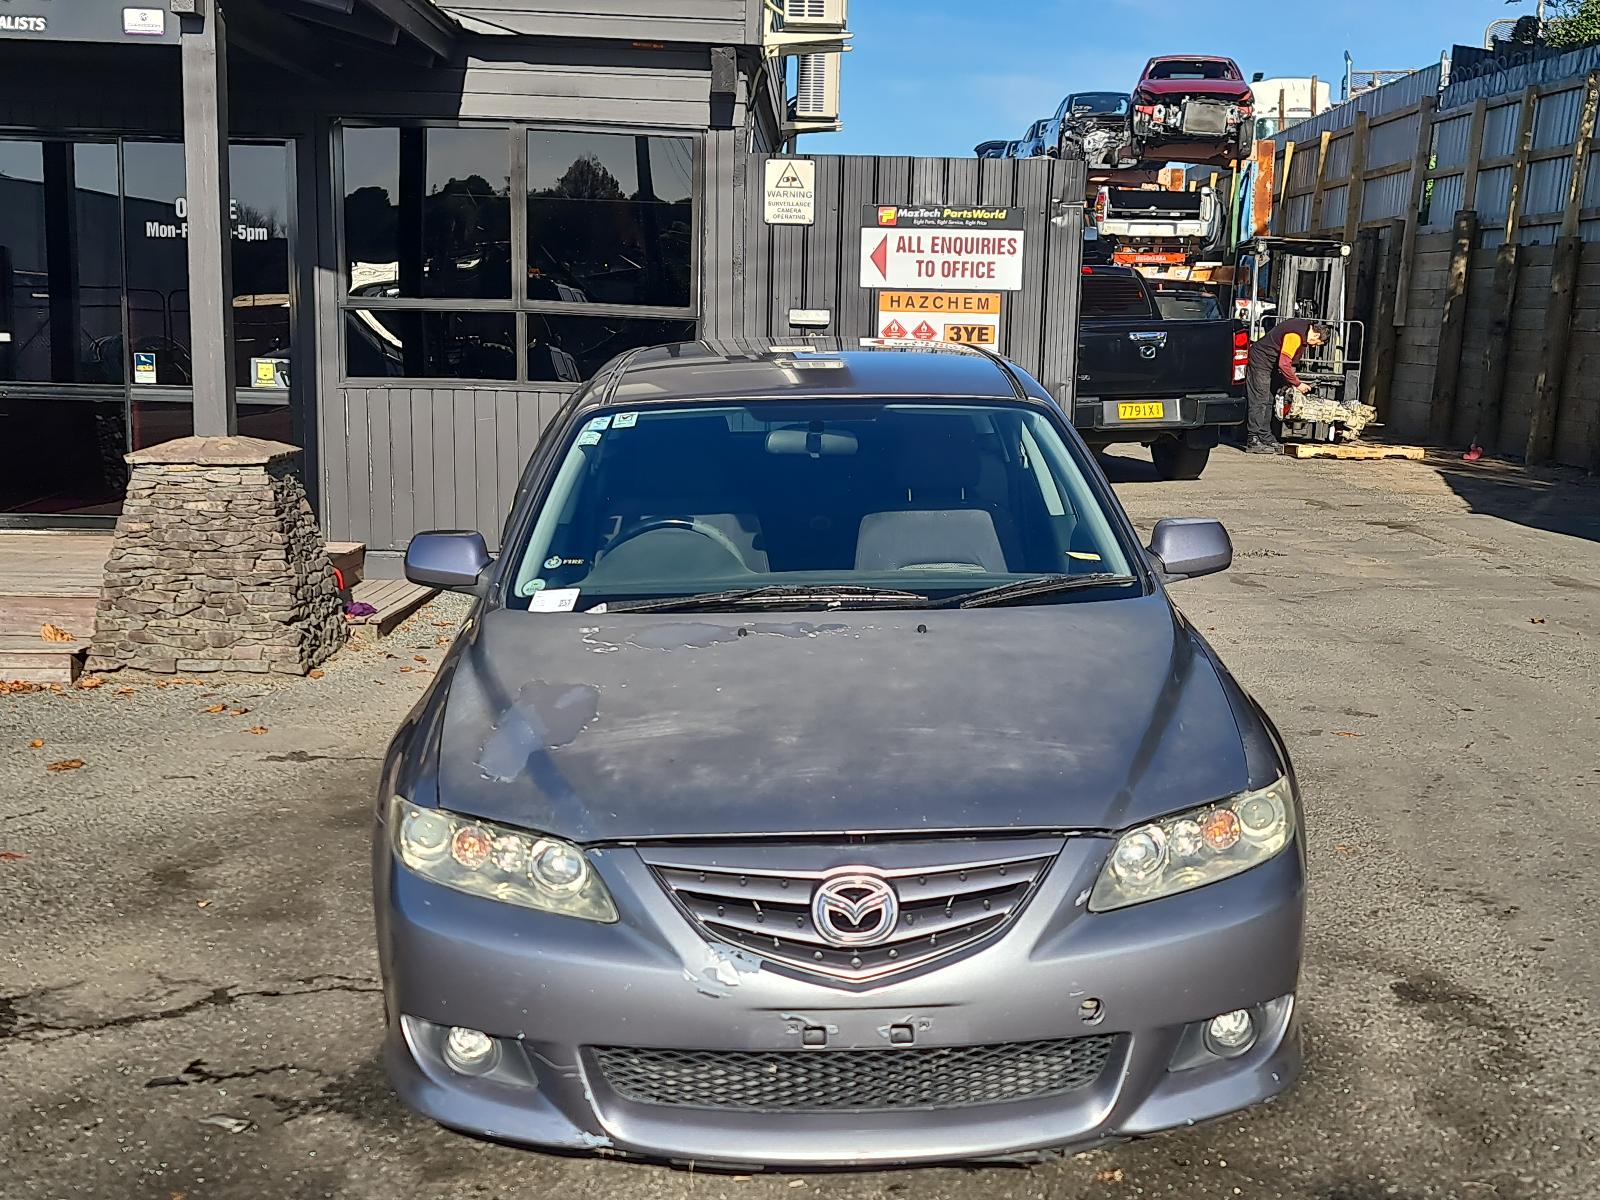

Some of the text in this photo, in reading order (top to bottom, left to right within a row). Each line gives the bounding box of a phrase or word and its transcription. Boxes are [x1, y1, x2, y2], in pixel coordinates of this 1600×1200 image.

[767, 190, 813, 199] WARNING
[943, 208, 1007, 219] PartsWorld
[146, 222, 268, 242] Mon-F -5pm
[896, 235, 1017, 256] ALL ENQUIRIES
[915, 260, 996, 279] TO OFFICE
[890, 295, 990, 310] HAZCHEM
[949, 326, 989, 342] 3YE
